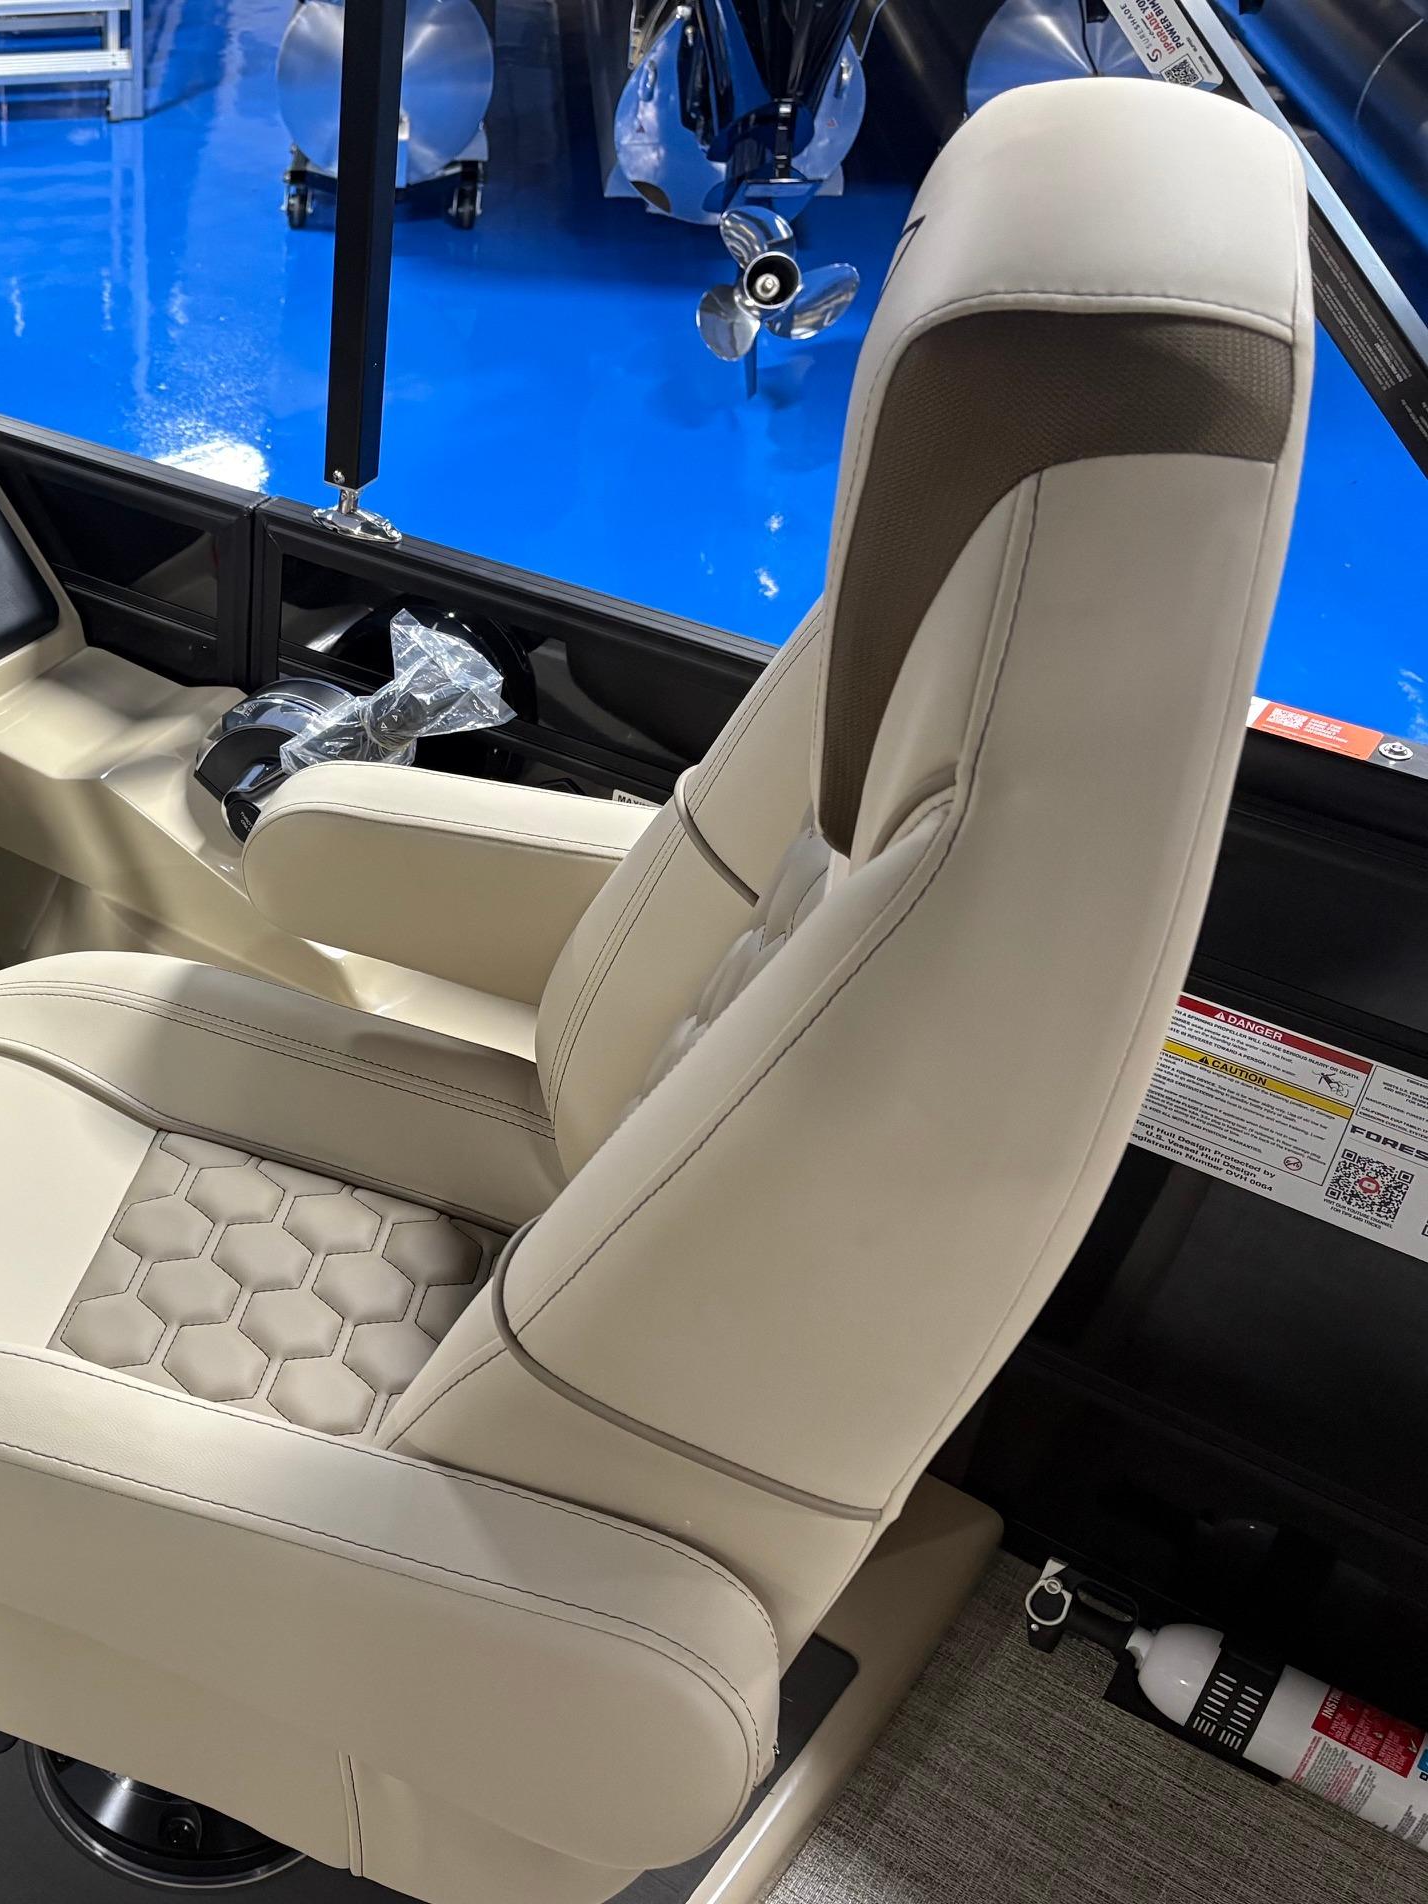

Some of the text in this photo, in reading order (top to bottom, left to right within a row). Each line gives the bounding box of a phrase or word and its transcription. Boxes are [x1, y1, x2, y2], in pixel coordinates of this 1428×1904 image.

[1120, 3, 1153, 49] SURESHADE
[1144, 11, 1176, 55] UPGRADE
[1160, 16, 1185, 49] POWER
[1213, 1023, 1247, 1039] PROPELLER
[1262, 1041, 1282, 1052] CAUSE
[1227, 1014, 1282, 1041] DANGER
[1186, 1033, 1212, 1045] REVERSE
[1213, 1043, 1237, 1055] TOWARD
[1243, 1054, 1266, 1065] PERSON
[1211, 1059, 1266, 1085] CAUTION
[1145, 1130, 1257, 1179] U.S. Vessel Hull Design
[1156, 1127, 1175, 1138] Hull
[1176, 1135, 1211, 1153] Design
[1213, 1149, 1261, 1172] Protected
[1262, 1169, 1276, 1179] by
[1184, 1153, 1223, 1172] Number
[1225, 1169, 1247, 1181] DVH
[1249, 1178, 1273, 1191] 0064
